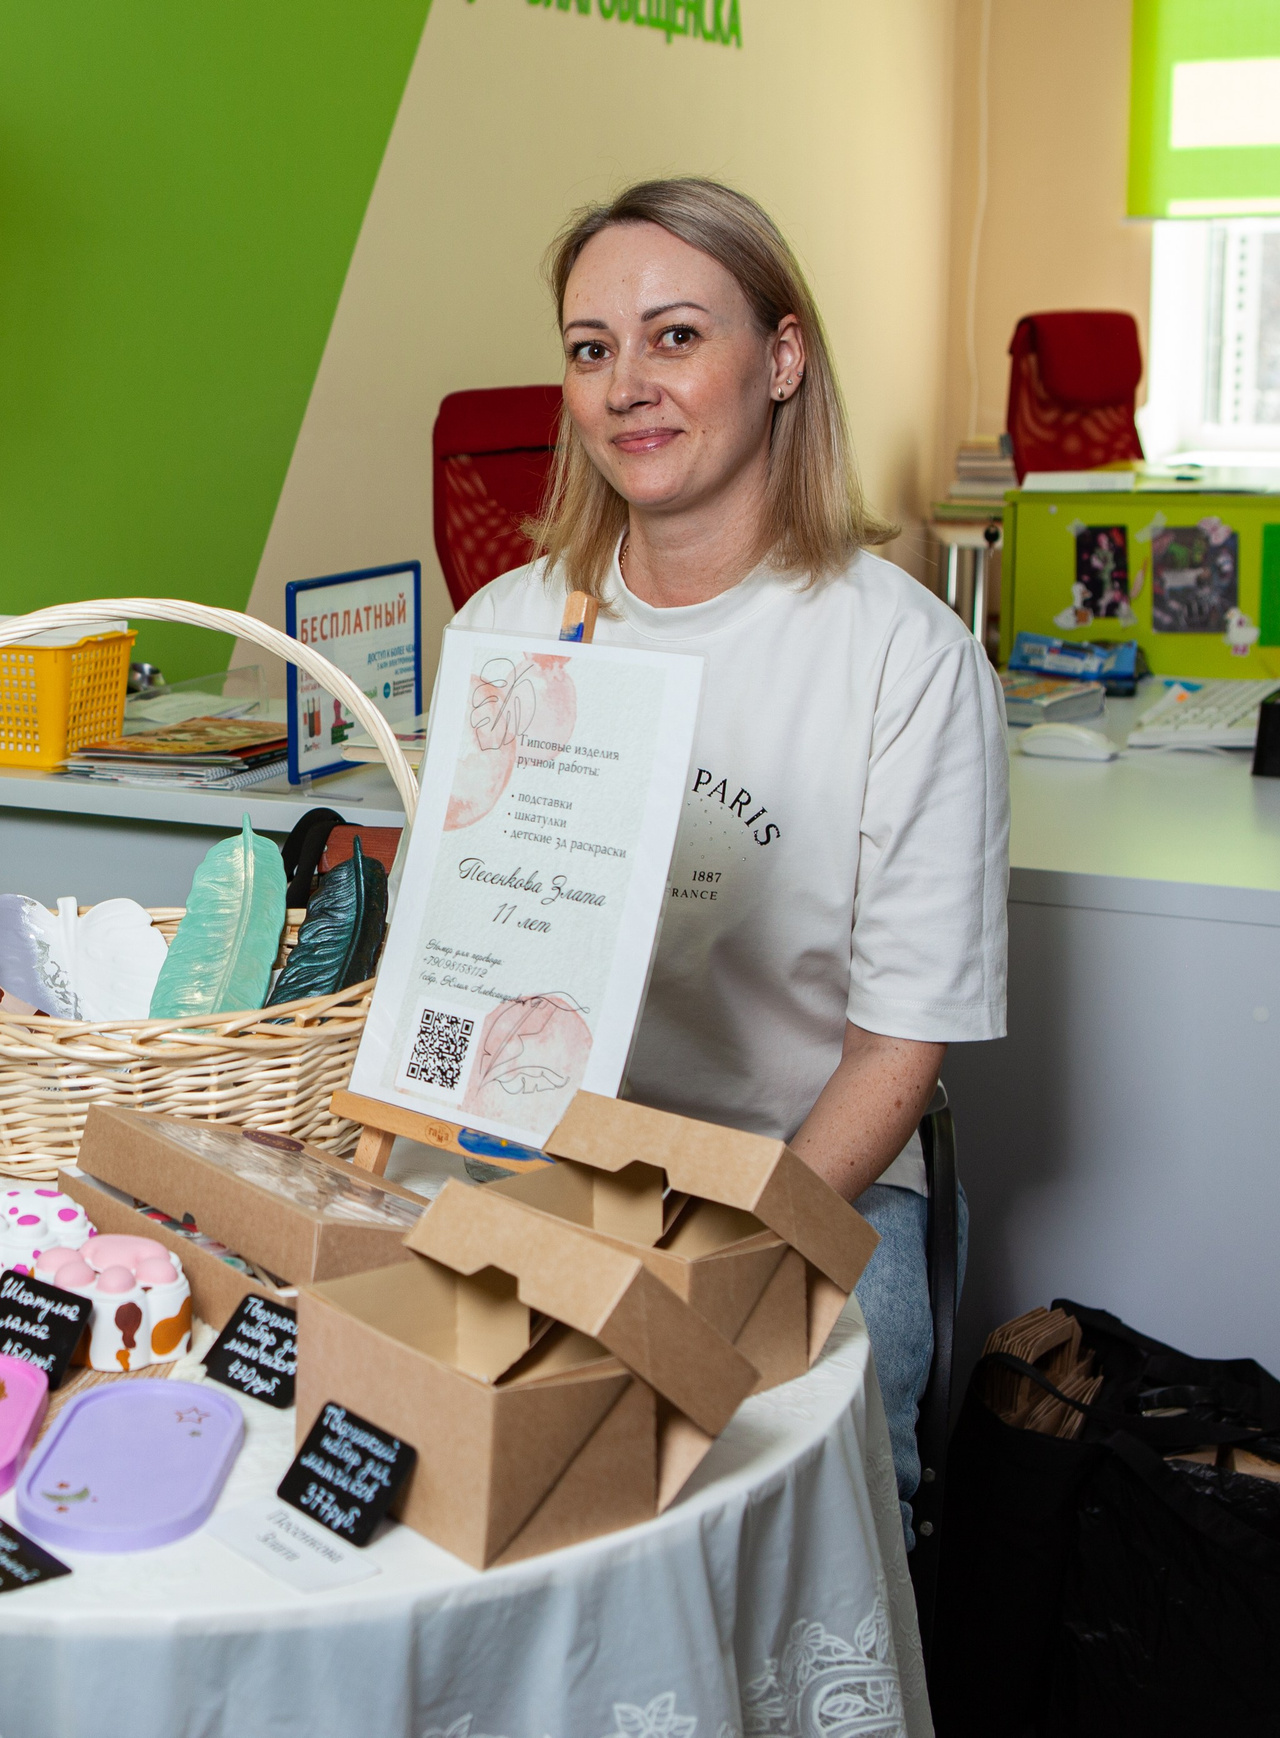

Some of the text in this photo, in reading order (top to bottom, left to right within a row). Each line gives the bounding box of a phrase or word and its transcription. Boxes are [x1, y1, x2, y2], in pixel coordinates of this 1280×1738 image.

[300, 592, 407, 643] БЕСПЛАТНЫЙ
[517, 733, 620, 761] Гипсовые изделия
[516, 755, 600, 777] ручной работы:
[518, 793, 573, 810] подставки
[692, 768, 781, 846] PARIS
[514, 811, 567, 829] шкатулки
[510, 829, 553, 845] детские
[570, 839, 627, 858] раскраски
[458, 857, 607, 907] Песенкова Злата
[692, 871, 722, 883] 1887
[492, 903, 552, 934] 11 лет
[426, 938, 453, 955] Номер
[0, 1276, 81, 1323] Шкатулка
[236, 1320, 277, 1353] набор
[227, 1359, 282, 1397] 430руб.
[322, 1404, 401, 1464] Творческий
